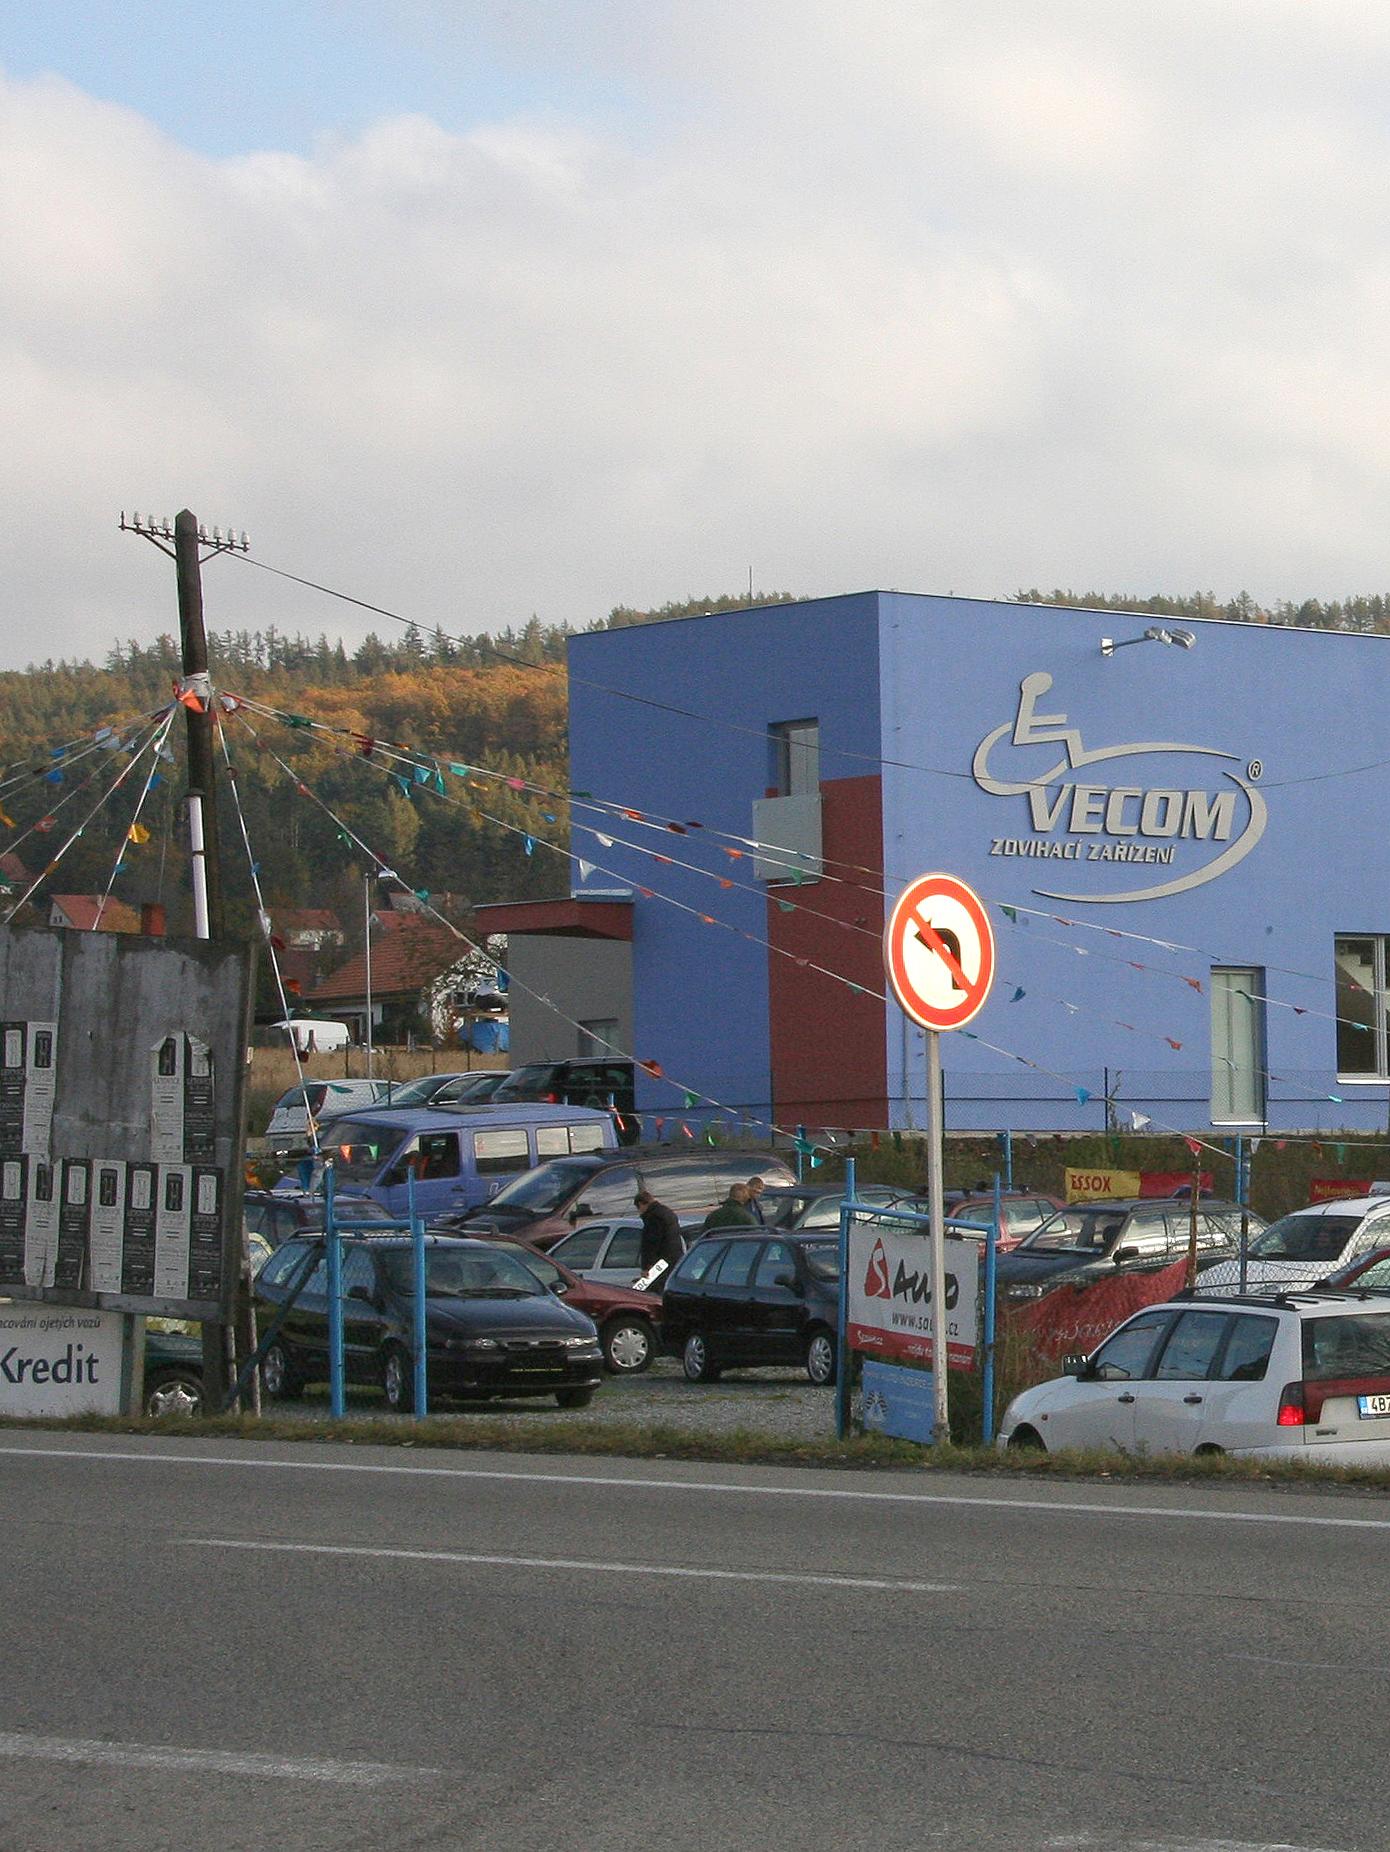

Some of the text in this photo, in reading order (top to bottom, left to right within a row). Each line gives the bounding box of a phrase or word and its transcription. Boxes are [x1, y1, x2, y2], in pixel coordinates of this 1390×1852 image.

[1029, 783, 1237, 840] VECOM
[990, 838, 1175, 865] ZDVIHACÍ ZAŘÍZENÍ
[1071, 1174, 1112, 1193] ESSOX
[39, 1315, 76, 1332] ojetých
[77, 1315, 101, 1329] vozů
